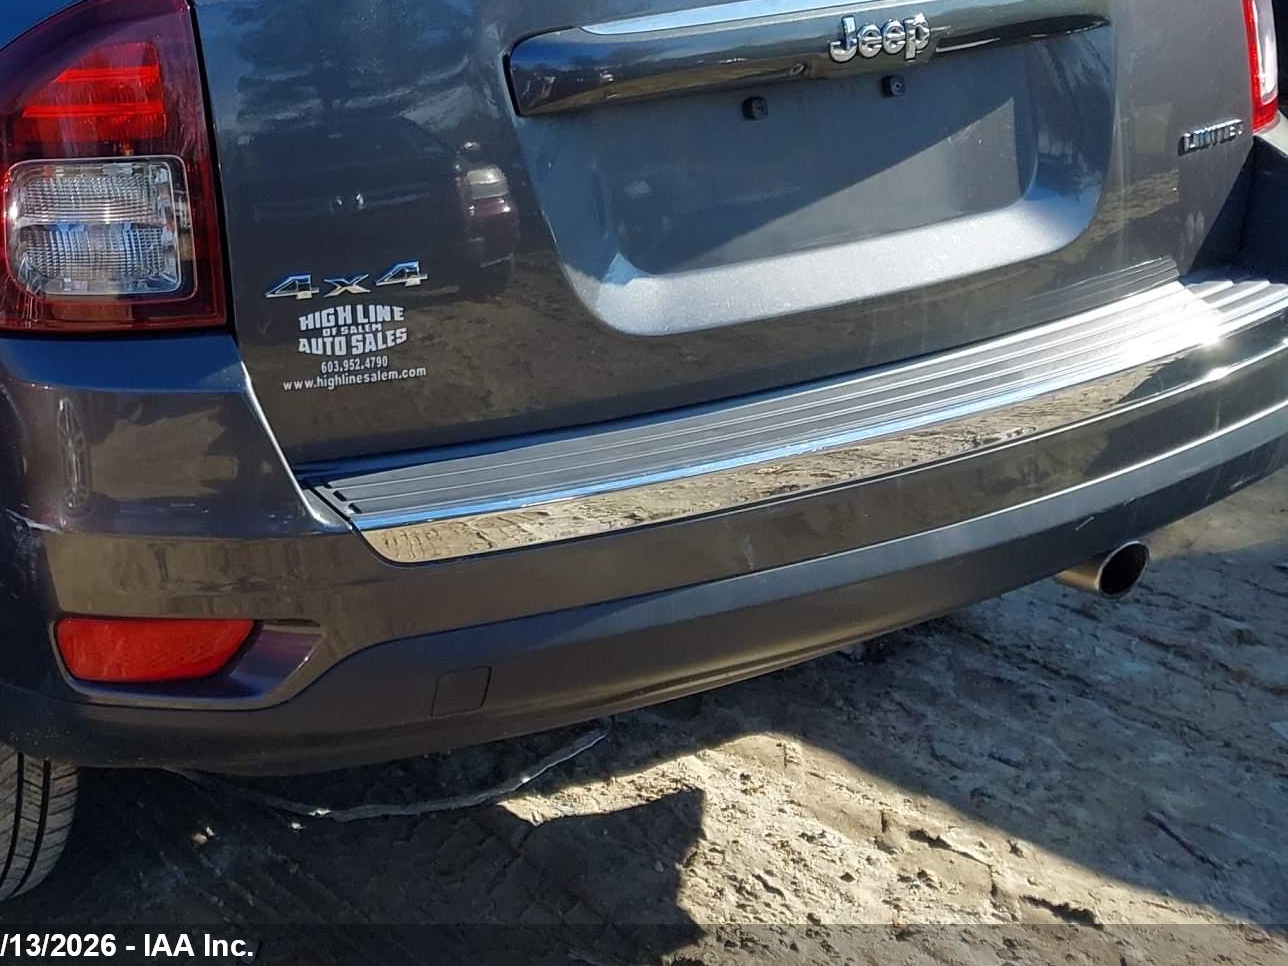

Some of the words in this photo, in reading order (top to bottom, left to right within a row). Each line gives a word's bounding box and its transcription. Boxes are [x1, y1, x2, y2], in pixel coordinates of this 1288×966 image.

[829, 13, 931, 63] Jeep
[298, 305, 352, 330] HIGH
[357, 305, 405, 323] LINE
[322, 327, 339, 336] OF
[341, 323, 382, 335] SALEM
[298, 336, 347, 355] AUTO
[351, 327, 407, 355] SALES
[321, 356, 388, 373] 603.952.4790
[283, 367, 427, 390] www.highlinesalem.com
